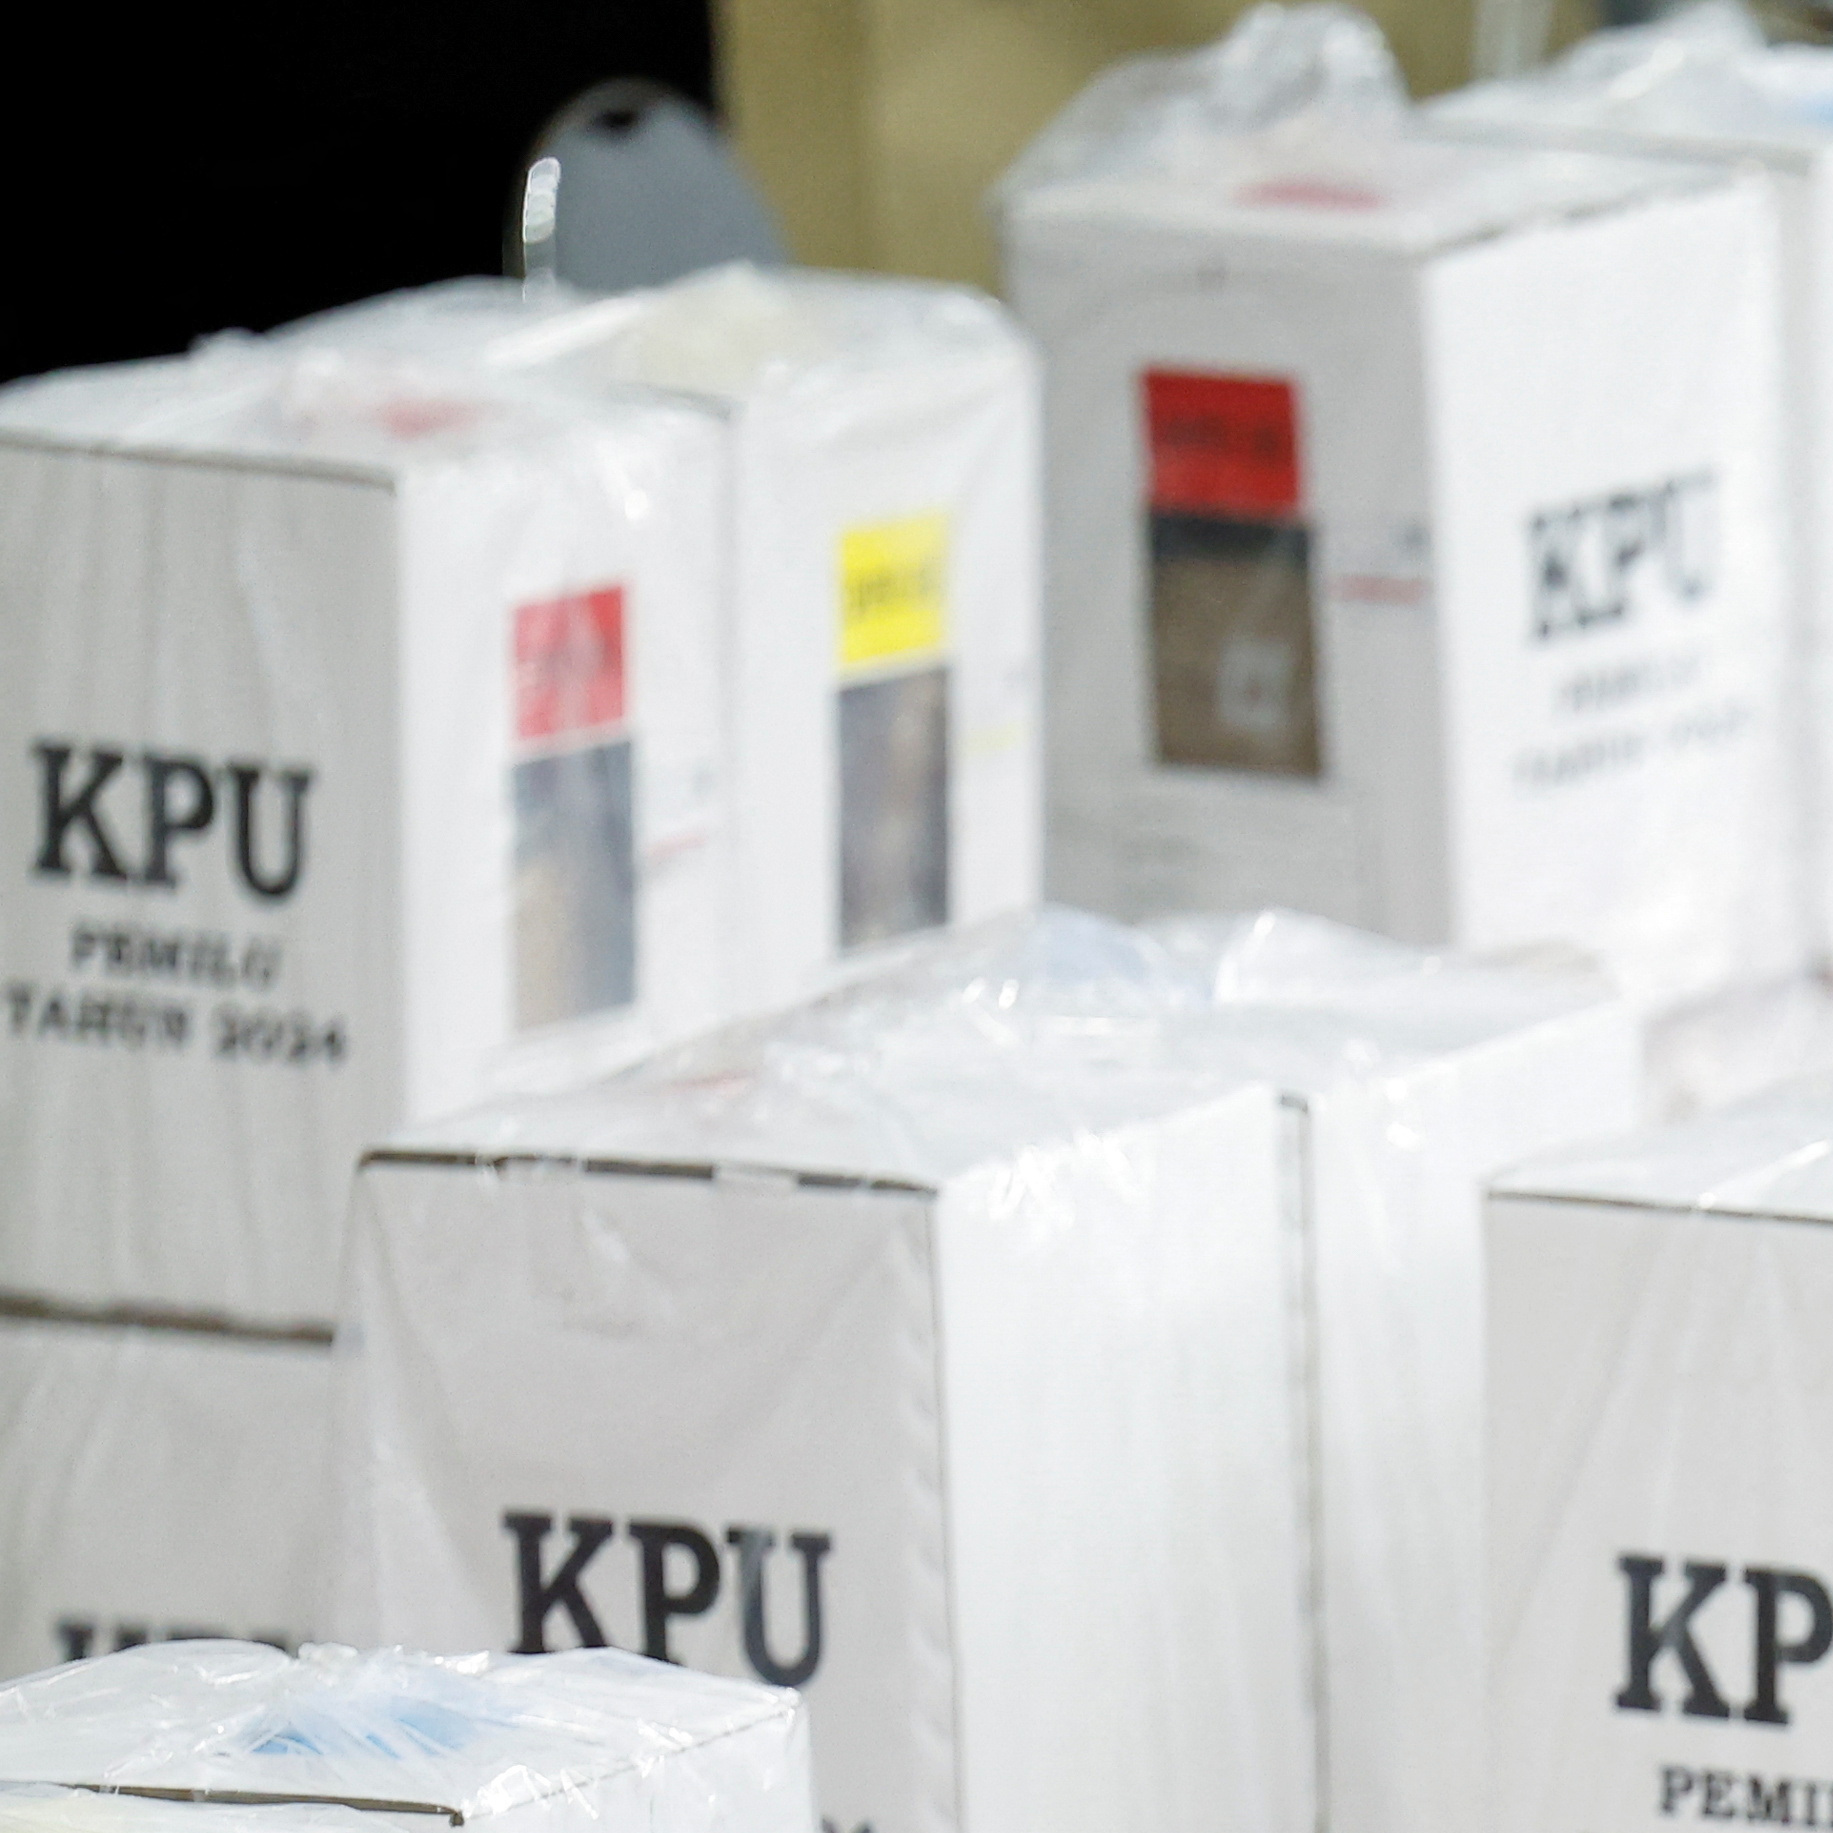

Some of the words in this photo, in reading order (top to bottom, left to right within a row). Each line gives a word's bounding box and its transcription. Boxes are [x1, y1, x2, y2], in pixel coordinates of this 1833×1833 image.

[1523, 465, 1726, 645] KPU
[34, 740, 314, 900] KPU
[500, 1508, 835, 1690] KPU
